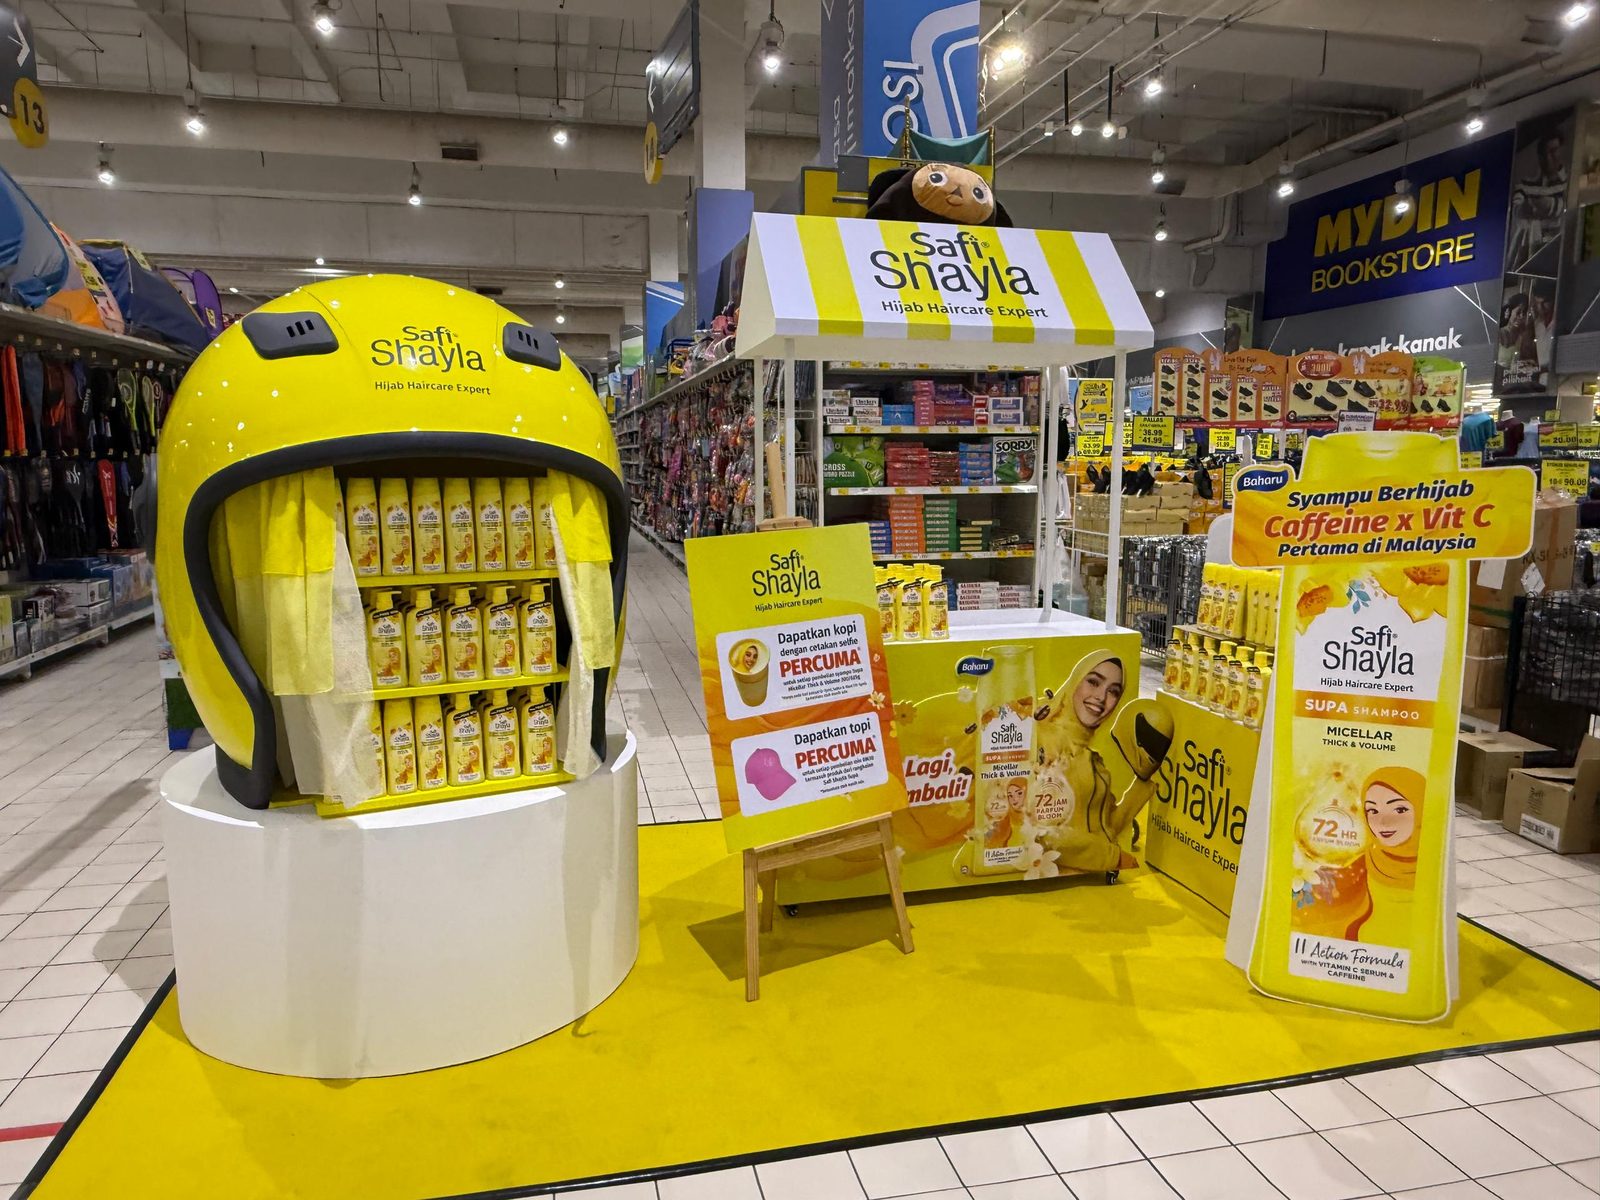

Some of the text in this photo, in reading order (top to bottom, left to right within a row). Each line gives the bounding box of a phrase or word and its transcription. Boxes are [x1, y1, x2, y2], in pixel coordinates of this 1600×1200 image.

[20, 94, 45, 135] 13
[1313, 168, 1482, 258] MYDIN
[910, 231, 983, 264] Safi
[1311, 233, 1475, 293] BOOKSTORE
[869, 250, 1040, 301] Shayla
[881, 300, 1049, 320] Hijab Haircare Expert
[402, 326, 453, 346] Safi
[371, 338, 486, 373] Shayla
[375, 380, 491, 395] Hijab Haircare Expert
[996, 439, 1036, 452] SORRY!
[1243, 474, 1283, 488] Baharu
[1287, 479, 1474, 511] Syampu Berhijab
[1264, 503, 1495, 543] Caffeine x Vit C
[1278, 532, 1476, 557] Pertama di Malaysia
[770, 549, 800, 572] Safi
[752, 566, 821, 598] Shayla
[755, 597, 823, 613] Hijab Haircare Expert
[777, 620, 857, 645] Dapatkan kopi
[1350, 625, 1393, 651] Safi
[780, 636, 859, 657] dengan cetakan selfie
[779, 649, 862, 678] PERCUMA
[962, 660, 989, 672] Baharu
[1322, 641, 1415, 679] Shayla
[1320, 677, 1414, 693] Hijab Haircare Expert
[1304, 698, 1420, 720] SUPA SHAMPOO
[794, 717, 871, 746] Dapatkan topi
[991, 731, 1023, 745] Shayla
[1000, 723, 1016, 734] Safi
[1327, 726, 1393, 741] MICELLAR
[795, 737, 877, 770] PERCUMA
[1322, 738, 1348, 748] THICK
[1358, 741, 1396, 752] VOLUME
[905, 751, 953, 779] Lagi,
[981, 772, 998, 780] Thick
[1006, 769, 1031, 777] Volume
[992, 763, 1018, 772] Micellar
[1183, 740, 1225, 791] Safi
[1035, 793, 1068, 808] 72 JAM
[1156, 755, 1247, 845] Shayla
[1037, 813, 1062, 821] BLOOM
[1313, 817, 1357, 840] 72 HR
[1151, 812, 1172, 835] Hijab
[1173, 826, 1210, 859] Haircare
[1310, 941, 1349, 961] Action
[1350, 948, 1405, 969] Formula
[1318, 960, 1351, 972] VITAMIN
[1360, 968, 1387, 978] SERUM
[1327, 970, 1366, 982] CAFFEINE
